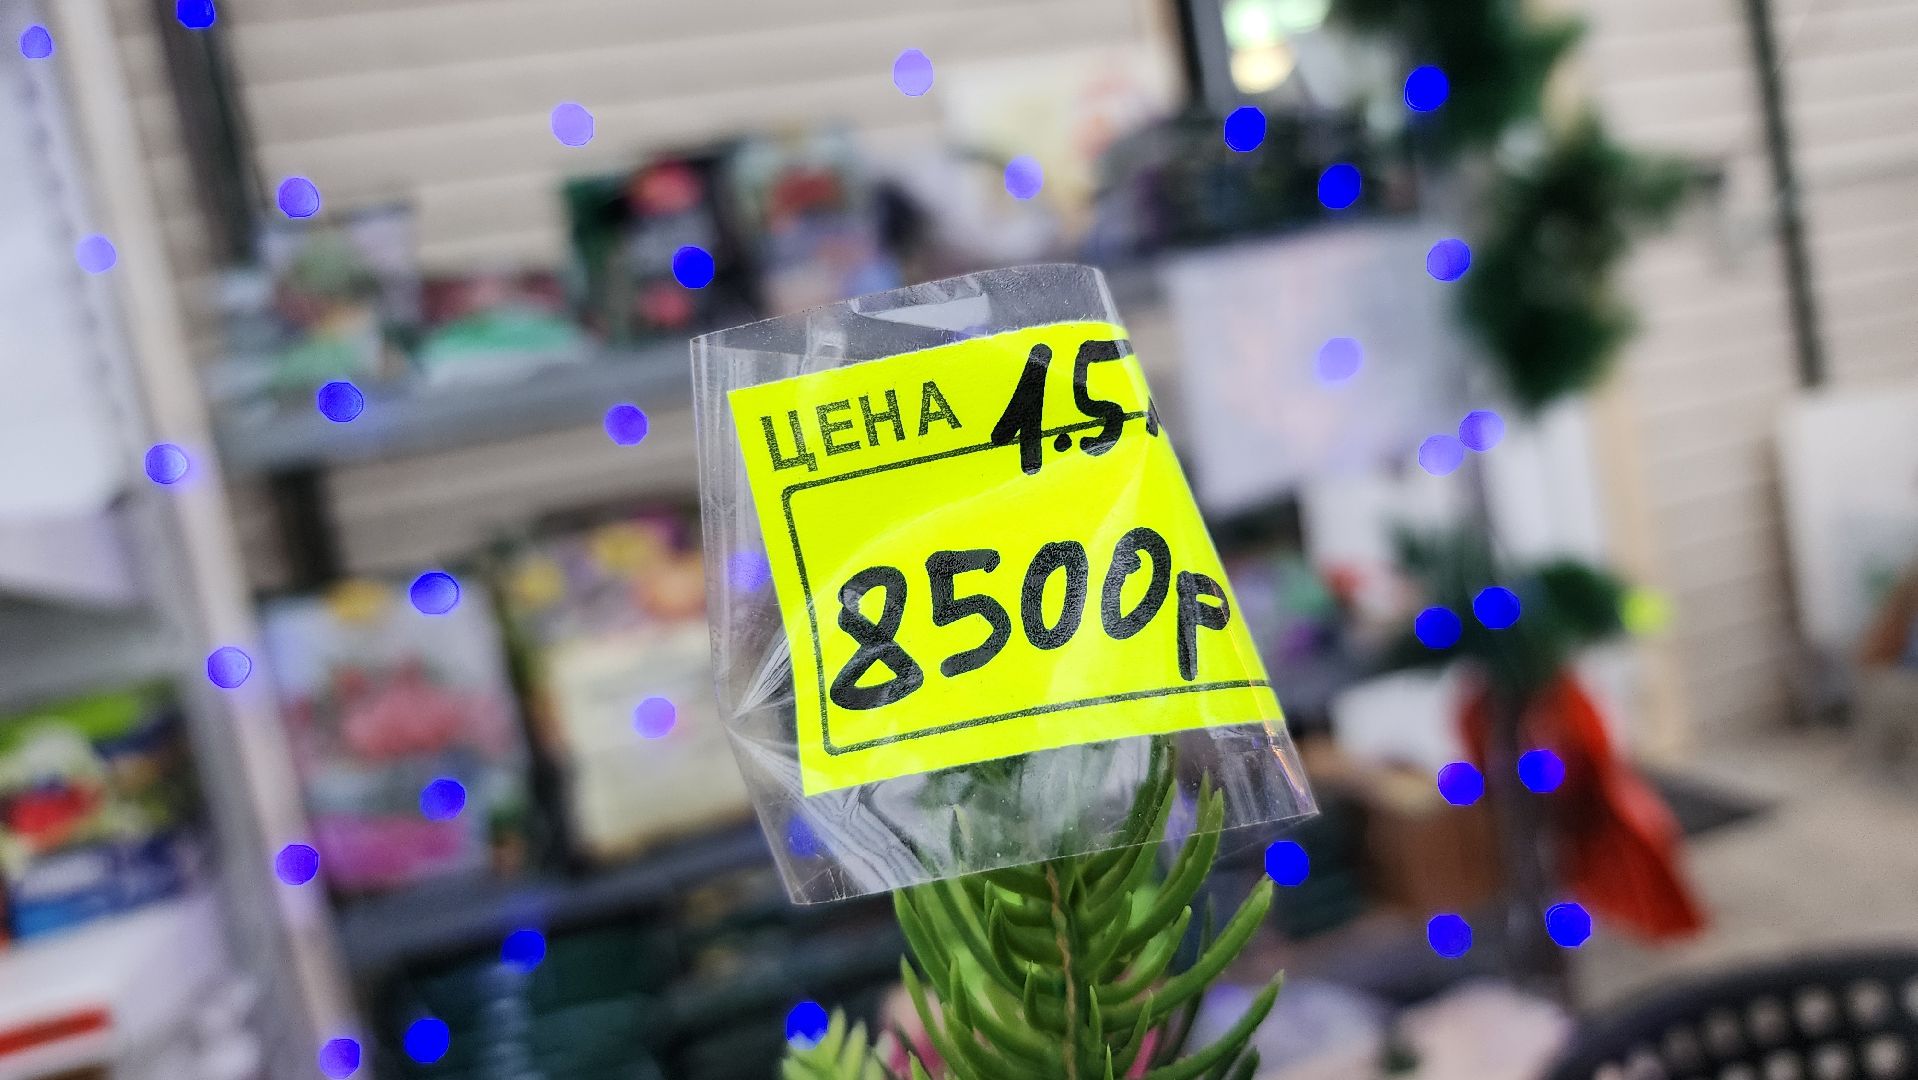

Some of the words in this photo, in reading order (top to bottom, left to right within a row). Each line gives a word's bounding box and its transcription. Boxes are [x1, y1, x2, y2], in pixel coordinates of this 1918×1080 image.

[760, 380, 962, 472] ЦЕНА
[990, 340, 1159, 475] 1.5
[831, 527, 1231, 710] 8500р
